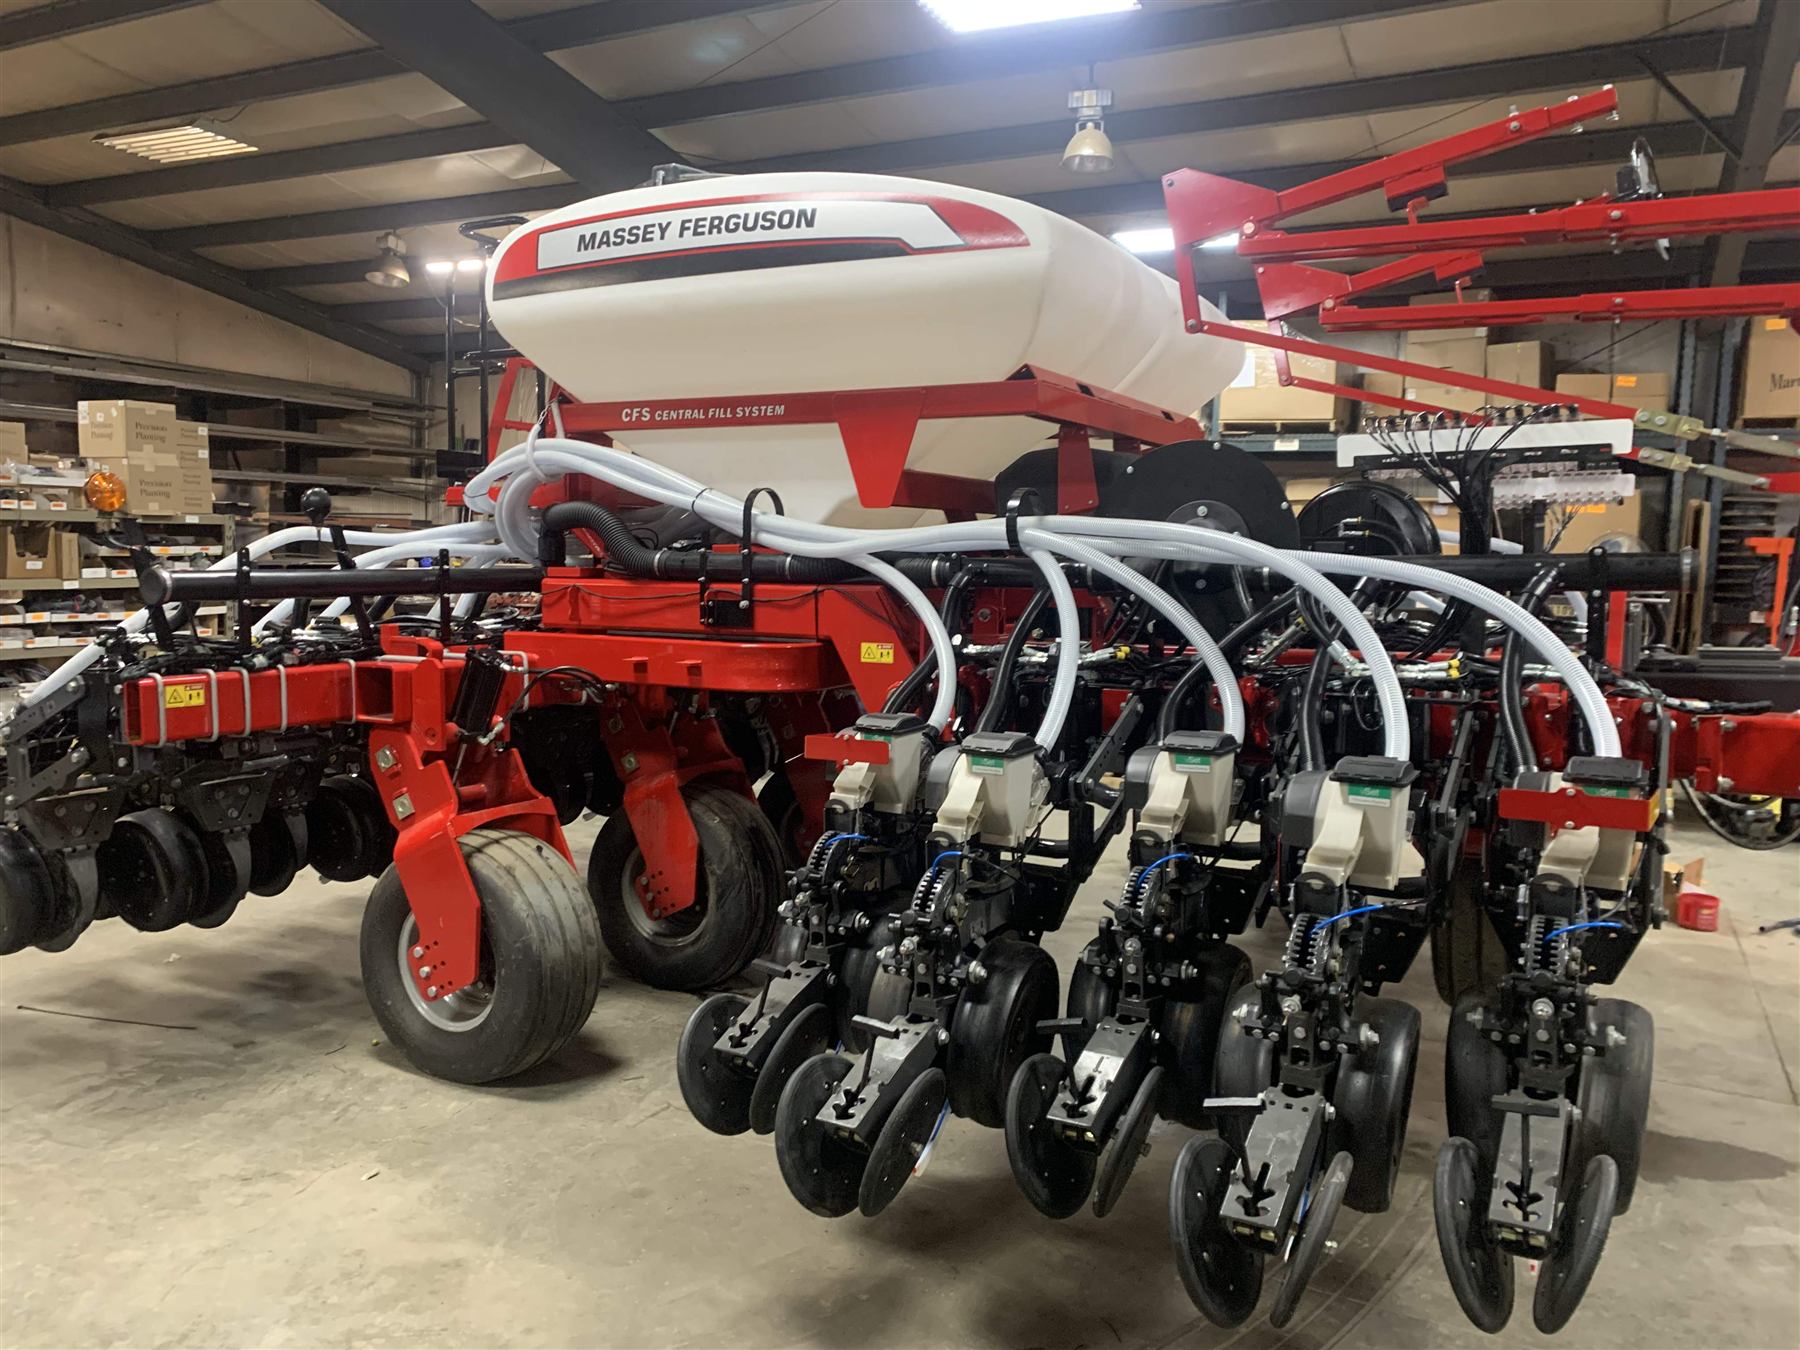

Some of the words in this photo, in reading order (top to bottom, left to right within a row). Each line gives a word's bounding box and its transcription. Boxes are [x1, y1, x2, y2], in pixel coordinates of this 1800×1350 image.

[577, 221, 672, 252] MASSEY
[678, 208, 817, 238] FERGUSON
[622, 407, 651, 422] CFS
[655, 408, 706, 421] CENTRAL
[708, 408, 733, 418] FILL
[736, 405, 785, 417] SYSTEM
